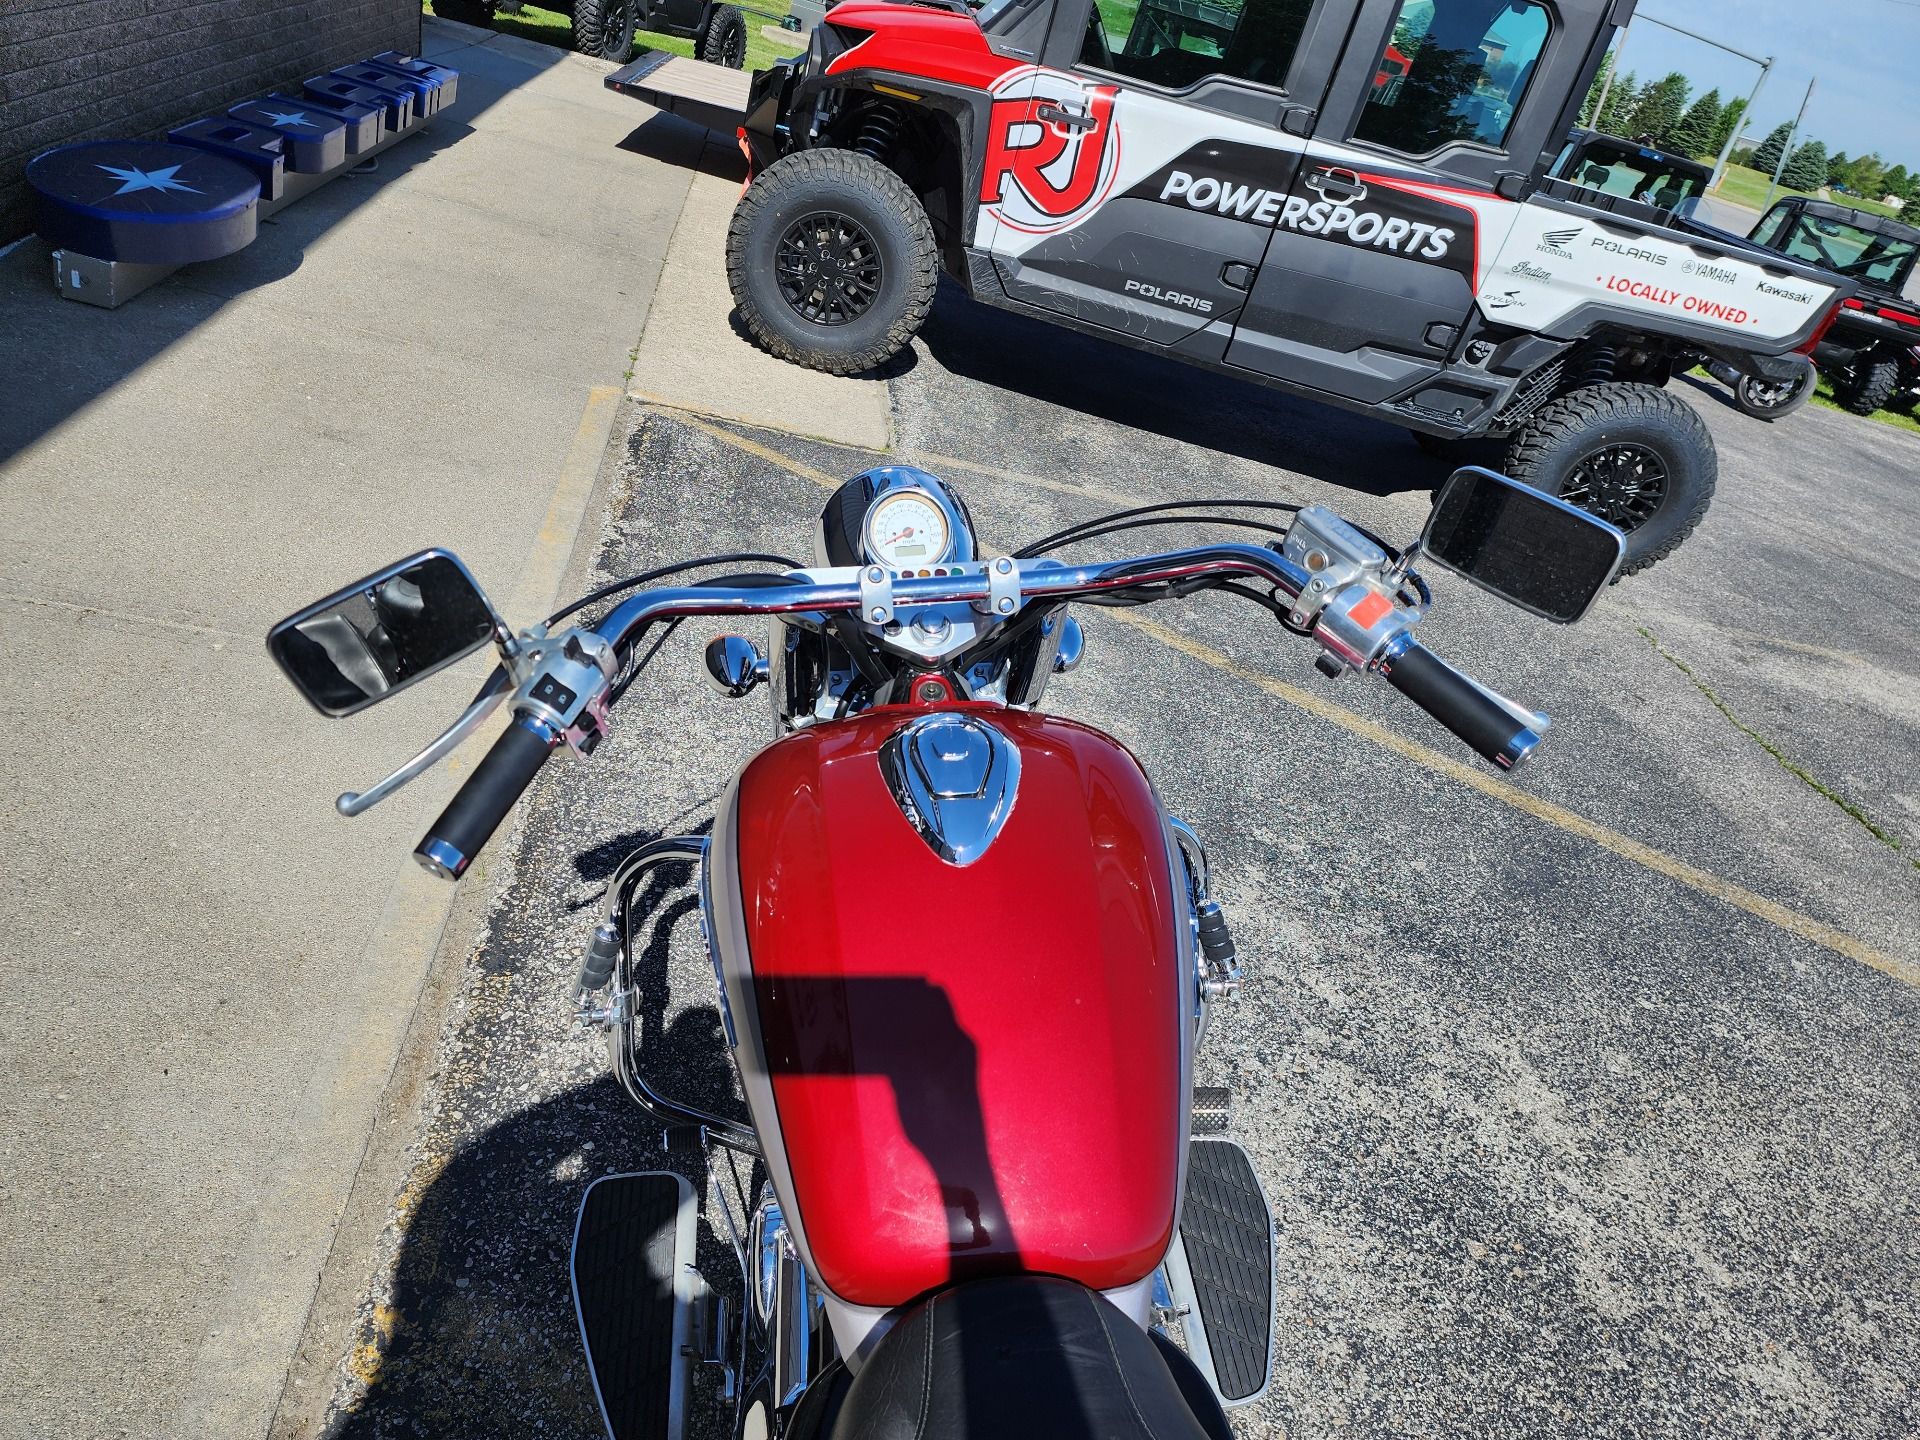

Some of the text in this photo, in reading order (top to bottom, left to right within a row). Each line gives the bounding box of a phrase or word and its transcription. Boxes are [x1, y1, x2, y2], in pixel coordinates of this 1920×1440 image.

[980, 82, 1122, 218] RJ
[1160, 170, 1455, 261] POWERSPORTS
[1535, 243, 1573, 260] HONDA
[1591, 237, 1668, 266] POLARIS
[1511, 261, 1552, 280] Indian
[1695, 262, 1737, 285] YAMAHA
[1124, 279, 1213, 313] POLARIS
[1606, 275, 1747, 323] LOCALLY OWNED
[1756, 280, 1814, 305] Kawasaki
